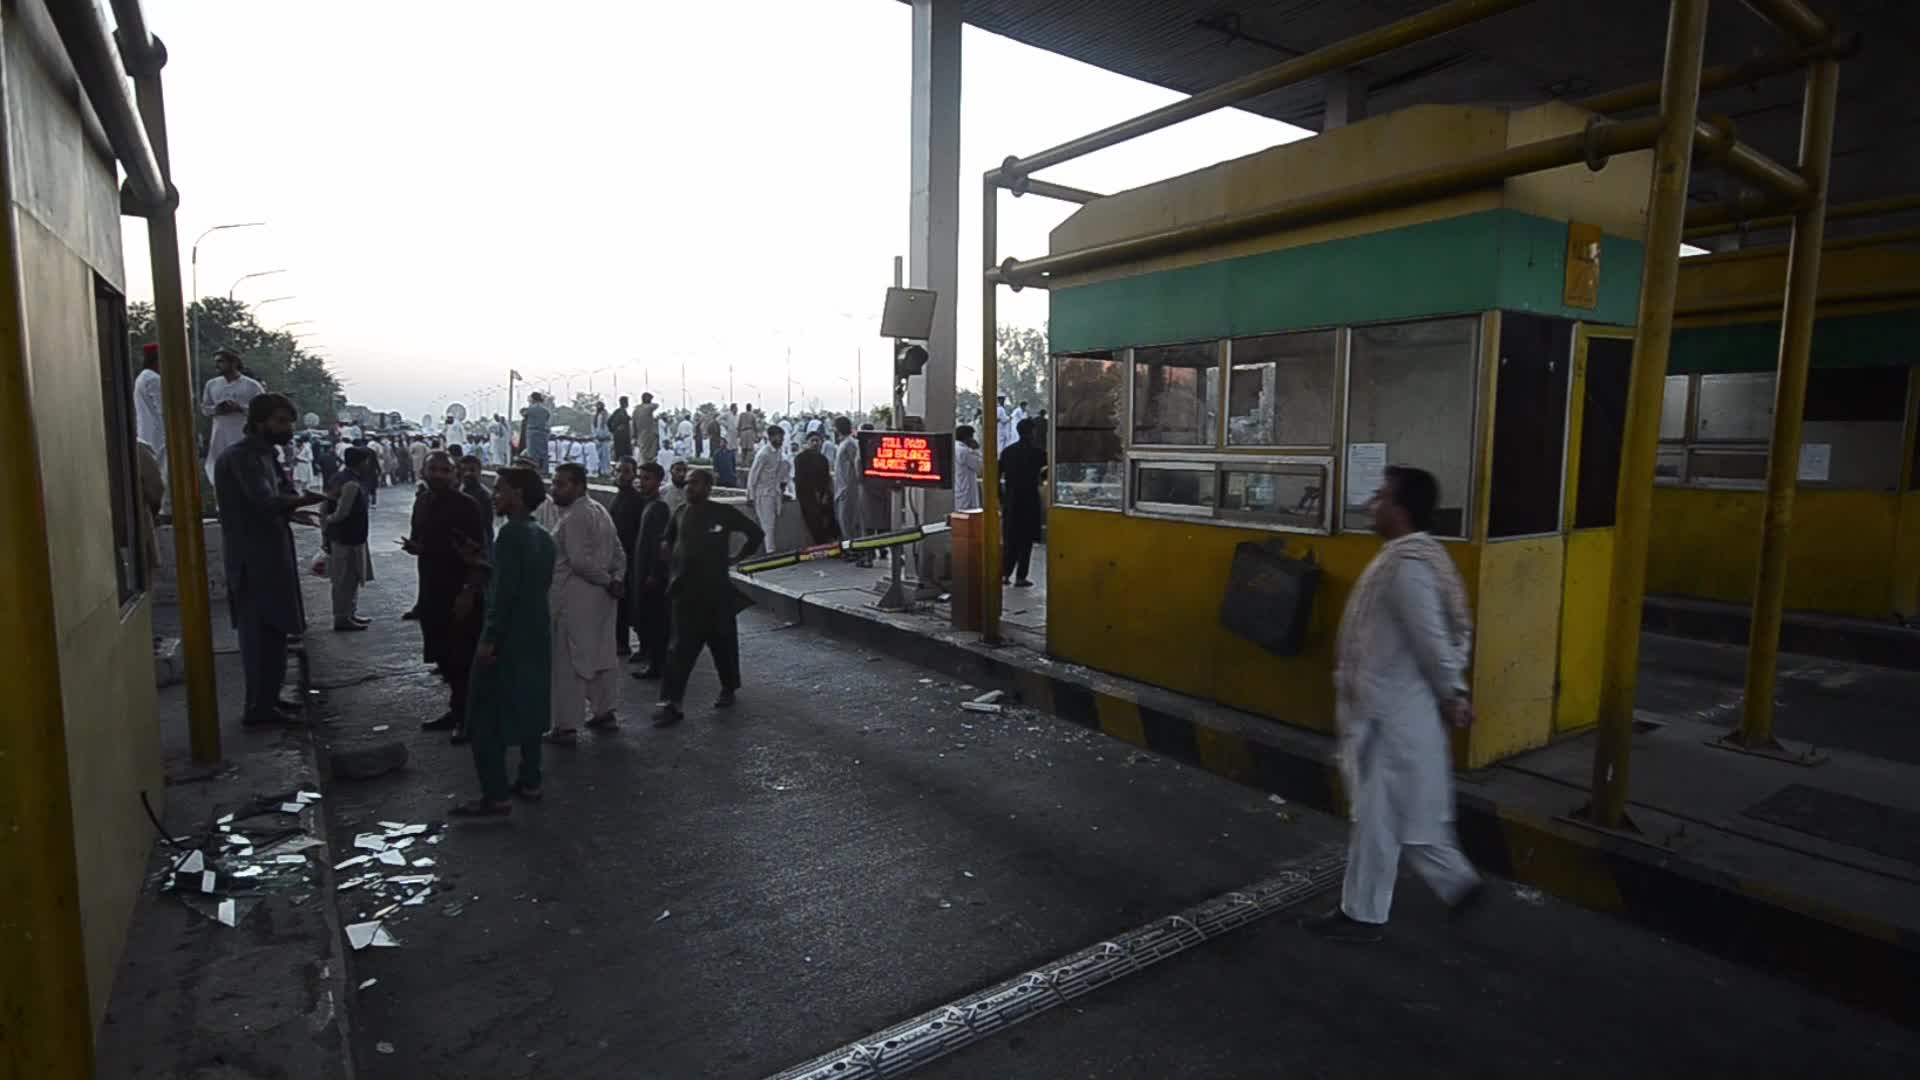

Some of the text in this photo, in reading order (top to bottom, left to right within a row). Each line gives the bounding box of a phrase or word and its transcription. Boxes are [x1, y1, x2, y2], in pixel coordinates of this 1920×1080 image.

[882, 437, 927, 449] TOLL PAID
[894, 449, 931, 460] BALANCE
